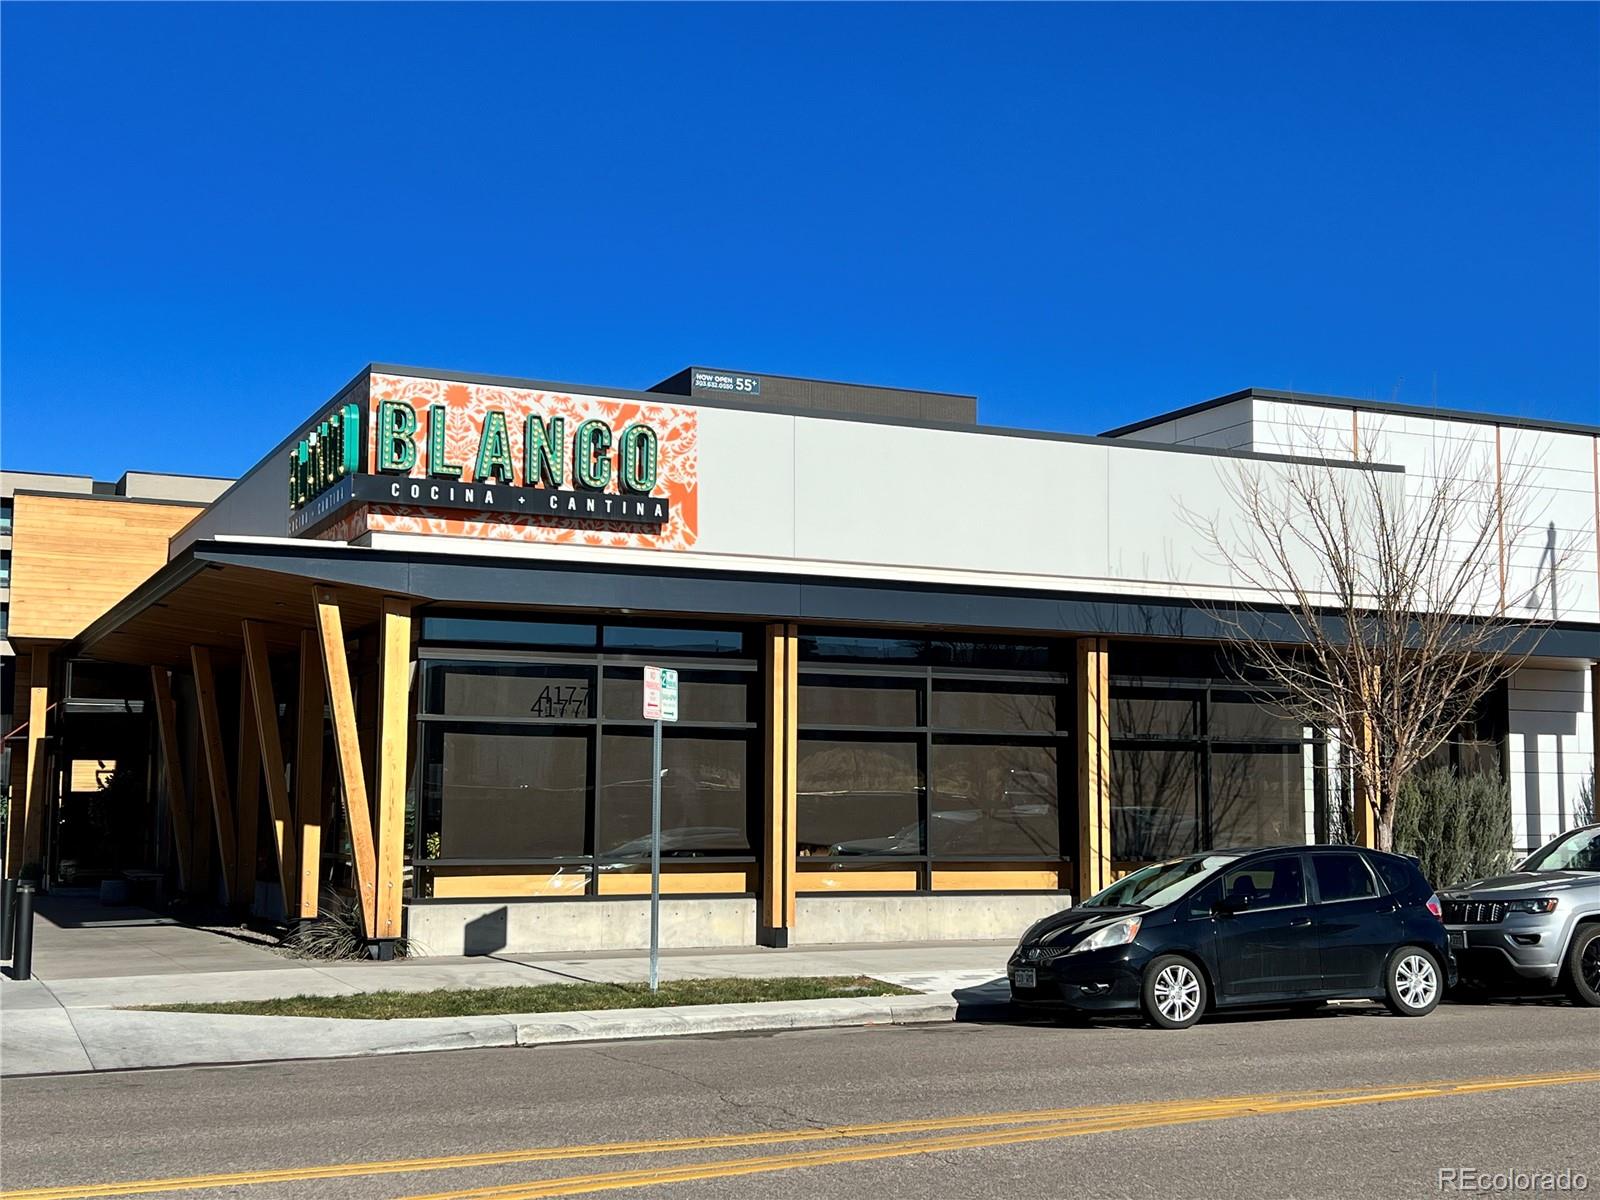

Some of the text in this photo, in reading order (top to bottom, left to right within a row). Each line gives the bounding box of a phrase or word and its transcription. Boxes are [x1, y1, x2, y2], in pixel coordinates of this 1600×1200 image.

[696, 373, 733, 384] NOW OPEN
[377, 399, 658, 494] BLANCO
[391, 482, 494, 505] COCINA
[549, 495, 663, 518] CANTINA
